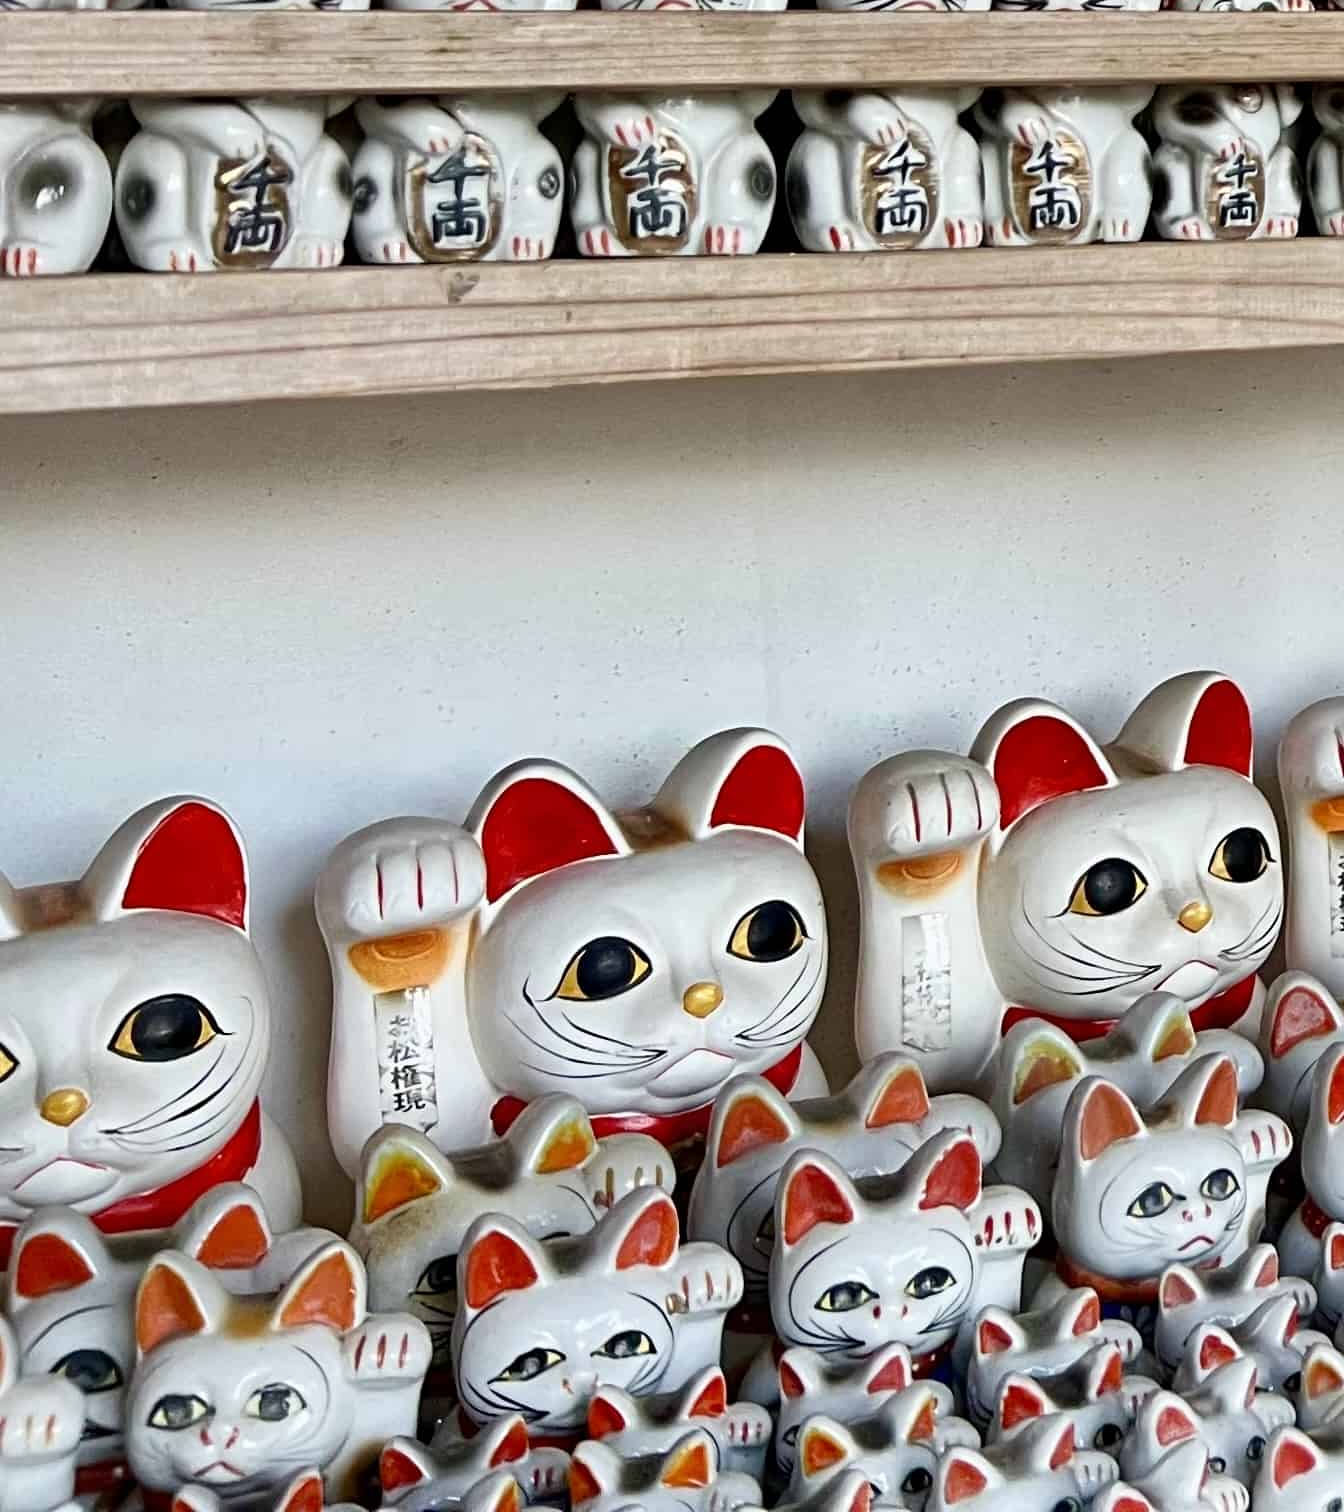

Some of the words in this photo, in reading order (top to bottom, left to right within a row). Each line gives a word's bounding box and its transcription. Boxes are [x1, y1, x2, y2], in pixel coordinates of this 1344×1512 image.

[225, 150, 293, 255] 千両
[427, 147, 491, 243] 千両
[623, 144, 688, 238] 千両
[874, 141, 929, 234] 千両
[1028, 139, 1078, 230] 千両
[1220, 153, 1259, 227] 千両
